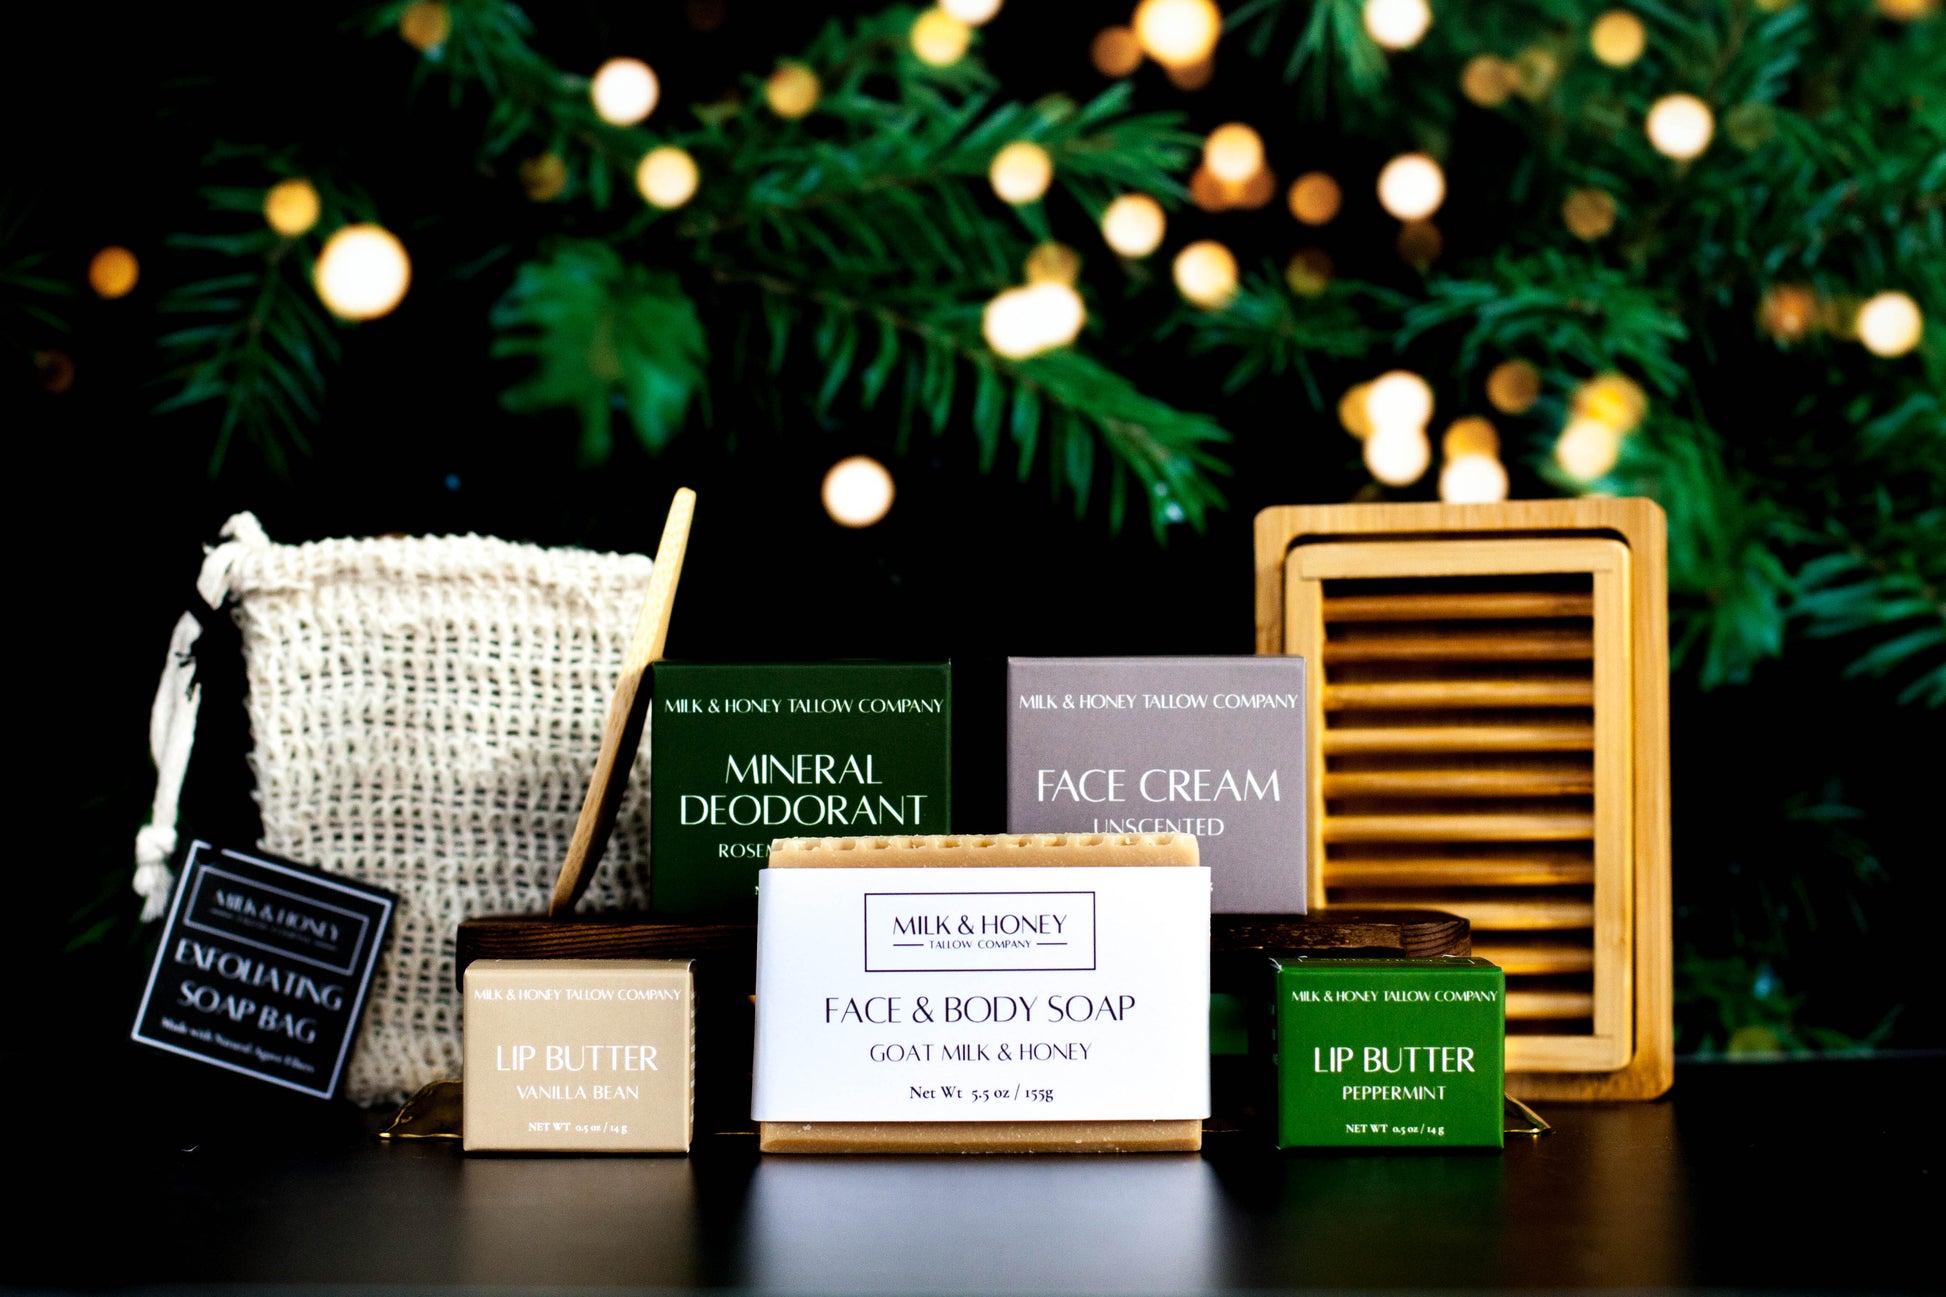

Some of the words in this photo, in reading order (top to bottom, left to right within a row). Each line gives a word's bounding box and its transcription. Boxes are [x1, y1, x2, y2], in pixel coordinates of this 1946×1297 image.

[665, 699, 703, 713] MILK
[708, 699, 720, 713] &
[725, 699, 782, 713] HONEY
[788, 699, 853, 713] TALLOW
[858, 699, 944, 713] COMPANY
[1019, 694, 1057, 709] MILK
[1062, 694, 1076, 709] &
[1080, 694, 1137, 709] HONEY
[1142, 694, 1208, 709] TALLOW
[1213, 694, 1298, 709] COMPANY
[725, 754, 883, 784] MINERAL
[1038, 768, 1126, 802] FACE
[1139, 768, 1281, 802] CREAM
[681, 795, 928, 825] DEODORANT
[1094, 818, 1225, 836] UNSCENTED
[893, 915, 951, 935] MILK
[957, 915, 975, 935] &
[981, 914, 1068, 935] HONEY
[929, 940, 973, 950] TALLOW
[977, 940, 1032, 950] COMPANY
[174, 937, 343, 1011] EXFOLIATING
[474, 988, 502, 1000] MILK
[506, 988, 516, 1000] &
[519, 988, 562, 1000] HONEY
[566, 988, 614, 1000] TALLOW
[617, 988, 682, 1000] COMPANY
[1292, 990, 1321, 1002] MILK
[1323, 990, 1333, 1002] &
[1336, 990, 1378, 1002] HONEY
[1383, 990, 1431, 1002] TALLOW
[1434, 990, 1498, 1002] COMPANY
[177, 979, 256, 1021] SOAP
[257, 1004, 317, 1044] BAG
[825, 997, 902, 1024] FACE
[912, 996, 935, 1024] &
[945, 996, 1038, 1023] BODY
[1048, 995, 1136, 1023] SOAP
[496, 1045, 536, 1071] LIP
[545, 1045, 659, 1071] BUTTER
[869, 1044, 935, 1062] GOAT
[942, 1044, 990, 1062] MILK
[997, 1044, 1013, 1062] &
[1019, 1043, 1092, 1061] HONEY
[1314, 1047, 1354, 1073] LIP
[1363, 1047, 1476, 1073] BUTTER
[516, 1085, 587, 1100] VANILLA
[593, 1085, 640, 1100] BEAN
[910, 1086, 936, 1099] Net
[941, 1086, 963, 1099] Wt
[971, 1089, 990, 1103] 5.5
[993, 1089, 1010, 1099] oz
[1013, 1084, 1021, 1101] /
[1024, 1088, 1054, 1103] 155g
[1342, 1086, 1446, 1101] PEPPERMINT
[528, 1122, 551, 1132] NET
[553, 1122, 572, 1132] WT
[621, 1125, 628, 1135] g
[1345, 1124, 1368, 1134] NET
[1369, 1124, 1388, 1134] WT
[1407, 1126, 1418, 1134] oz
[1438, 1126, 1445, 1136] g
